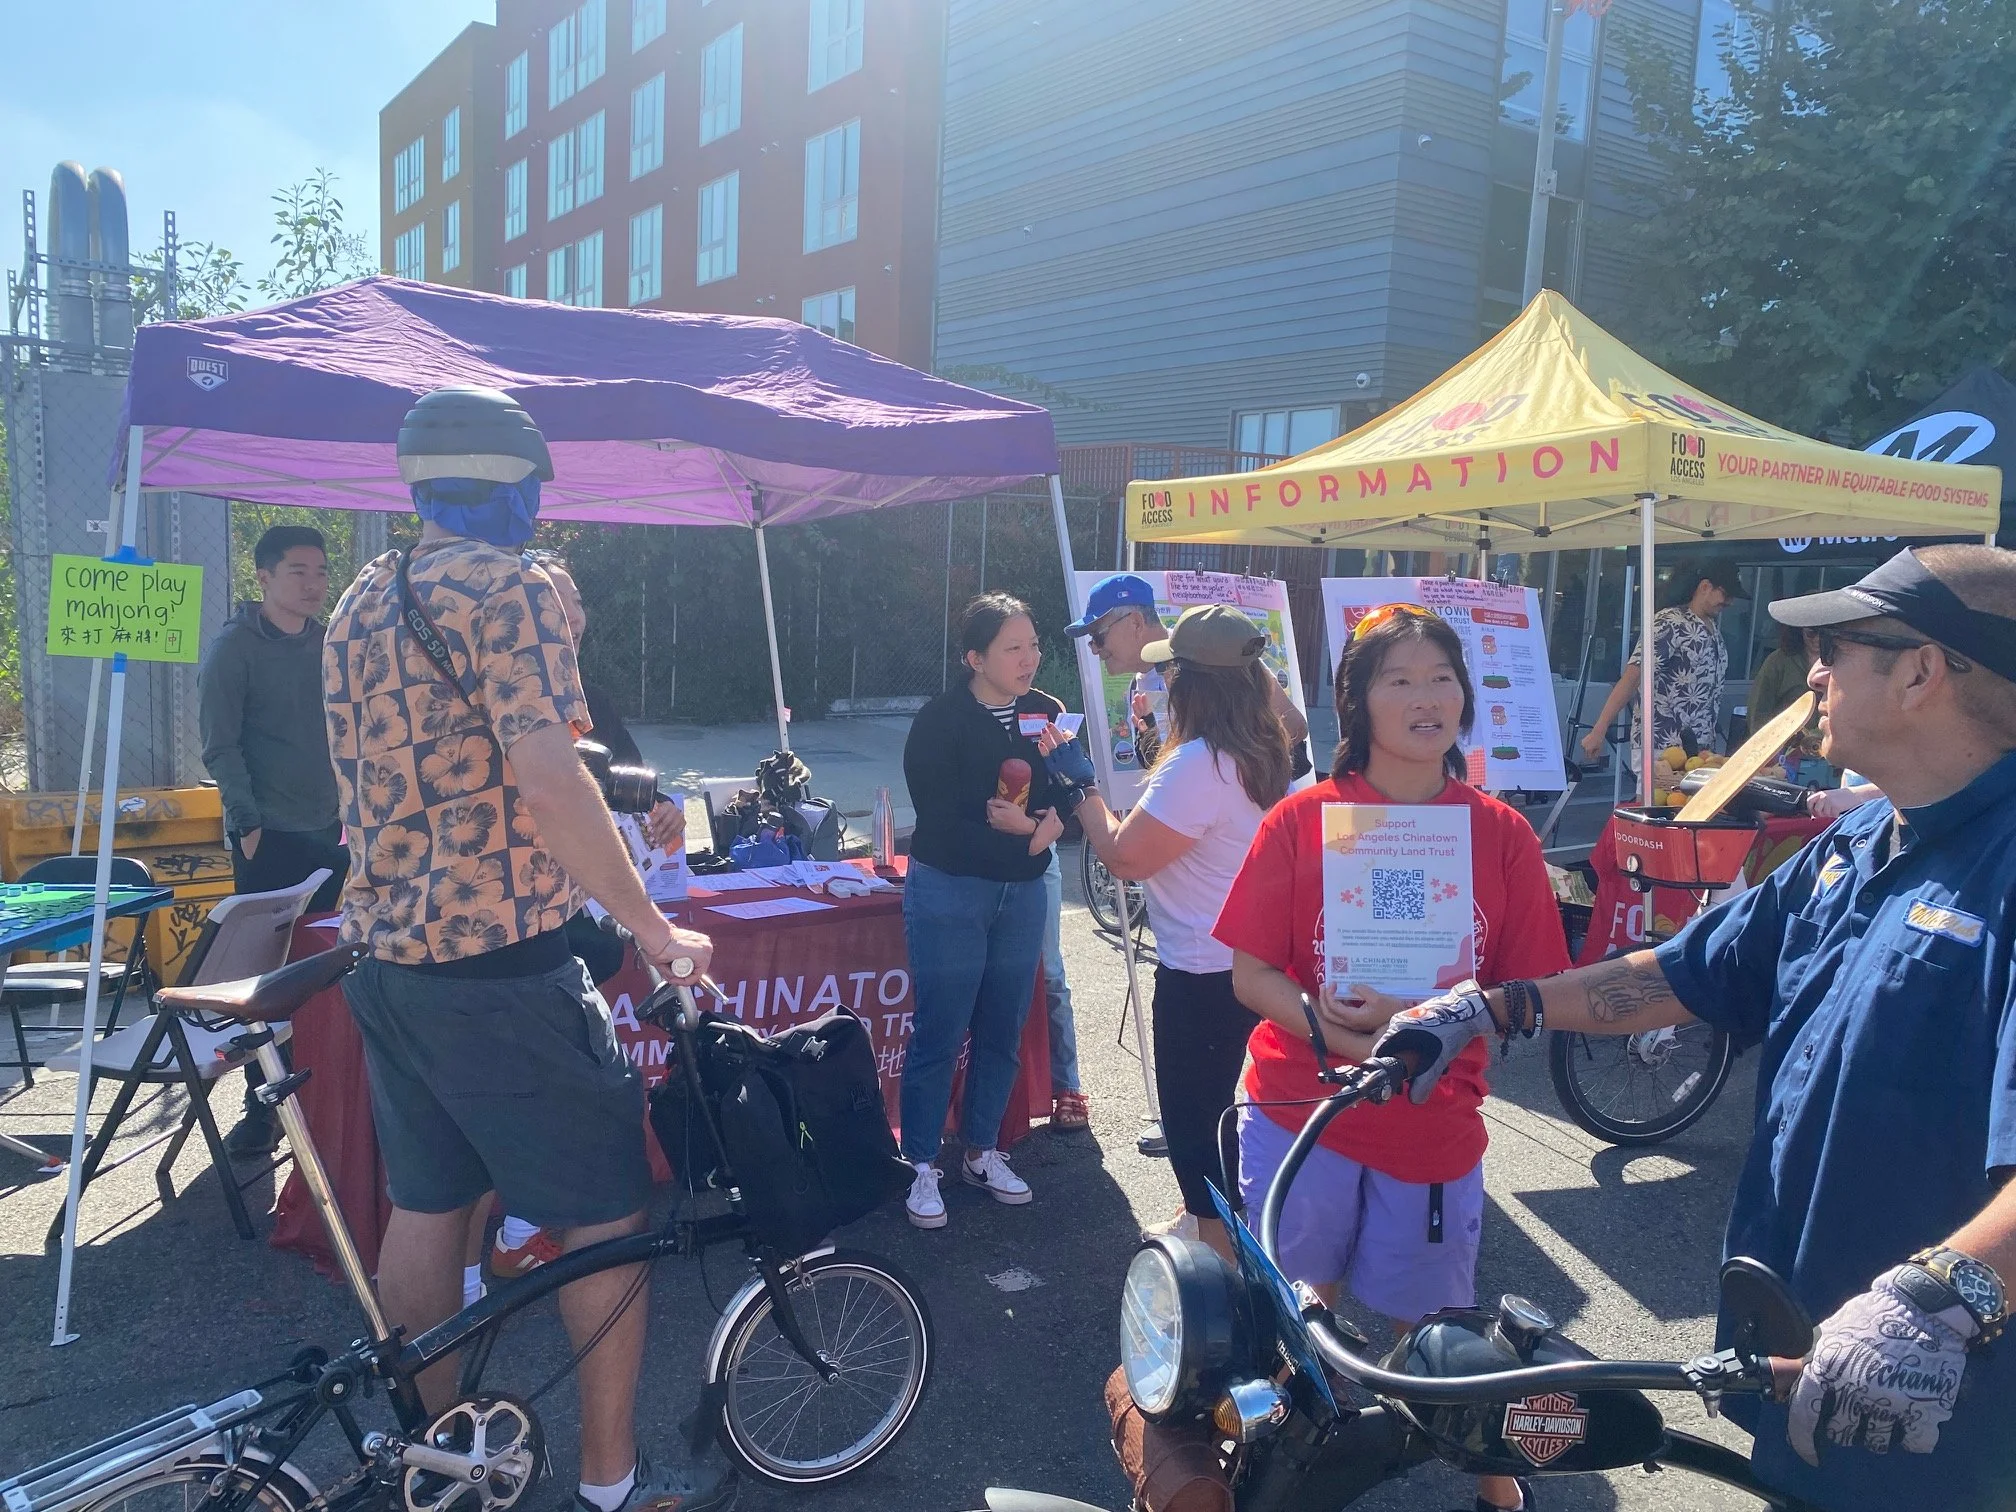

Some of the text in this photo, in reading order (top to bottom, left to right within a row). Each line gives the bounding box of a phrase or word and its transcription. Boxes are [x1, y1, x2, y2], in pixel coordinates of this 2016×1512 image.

[190, 359, 225, 376] QUEST
[1188, 437, 1619, 517] INFORMATION
[1670, 458, 1705, 479] ACCESS
[1717, 452, 1989, 508] YOUR PARTNER IN EQUITABLE FOOD SYSTEMS
[1141, 509, 1173, 525] ACCESS
[142, 569, 186, 605] play
[66, 596, 175, 630] mahjong!
[1428, 605, 1470, 617] ATOWN
[407, 609, 432, 641] EOS
[427, 640, 446, 658] 5D
[1374, 818, 1416, 830] Support
[1337, 832, 1458, 843] Los Angeles Chinatown
[1616, 832, 1664, 850] DOORDASH
[1340, 846, 1455, 857] Community Land Trust
[611, 993, 641, 1032] A
[1532, 1398, 1569, 1412] MOTOR
[1512, 1414, 1583, 1435] HARLEY-DAVIDSON
[1526, 1438, 1563, 1457] CYCLES
